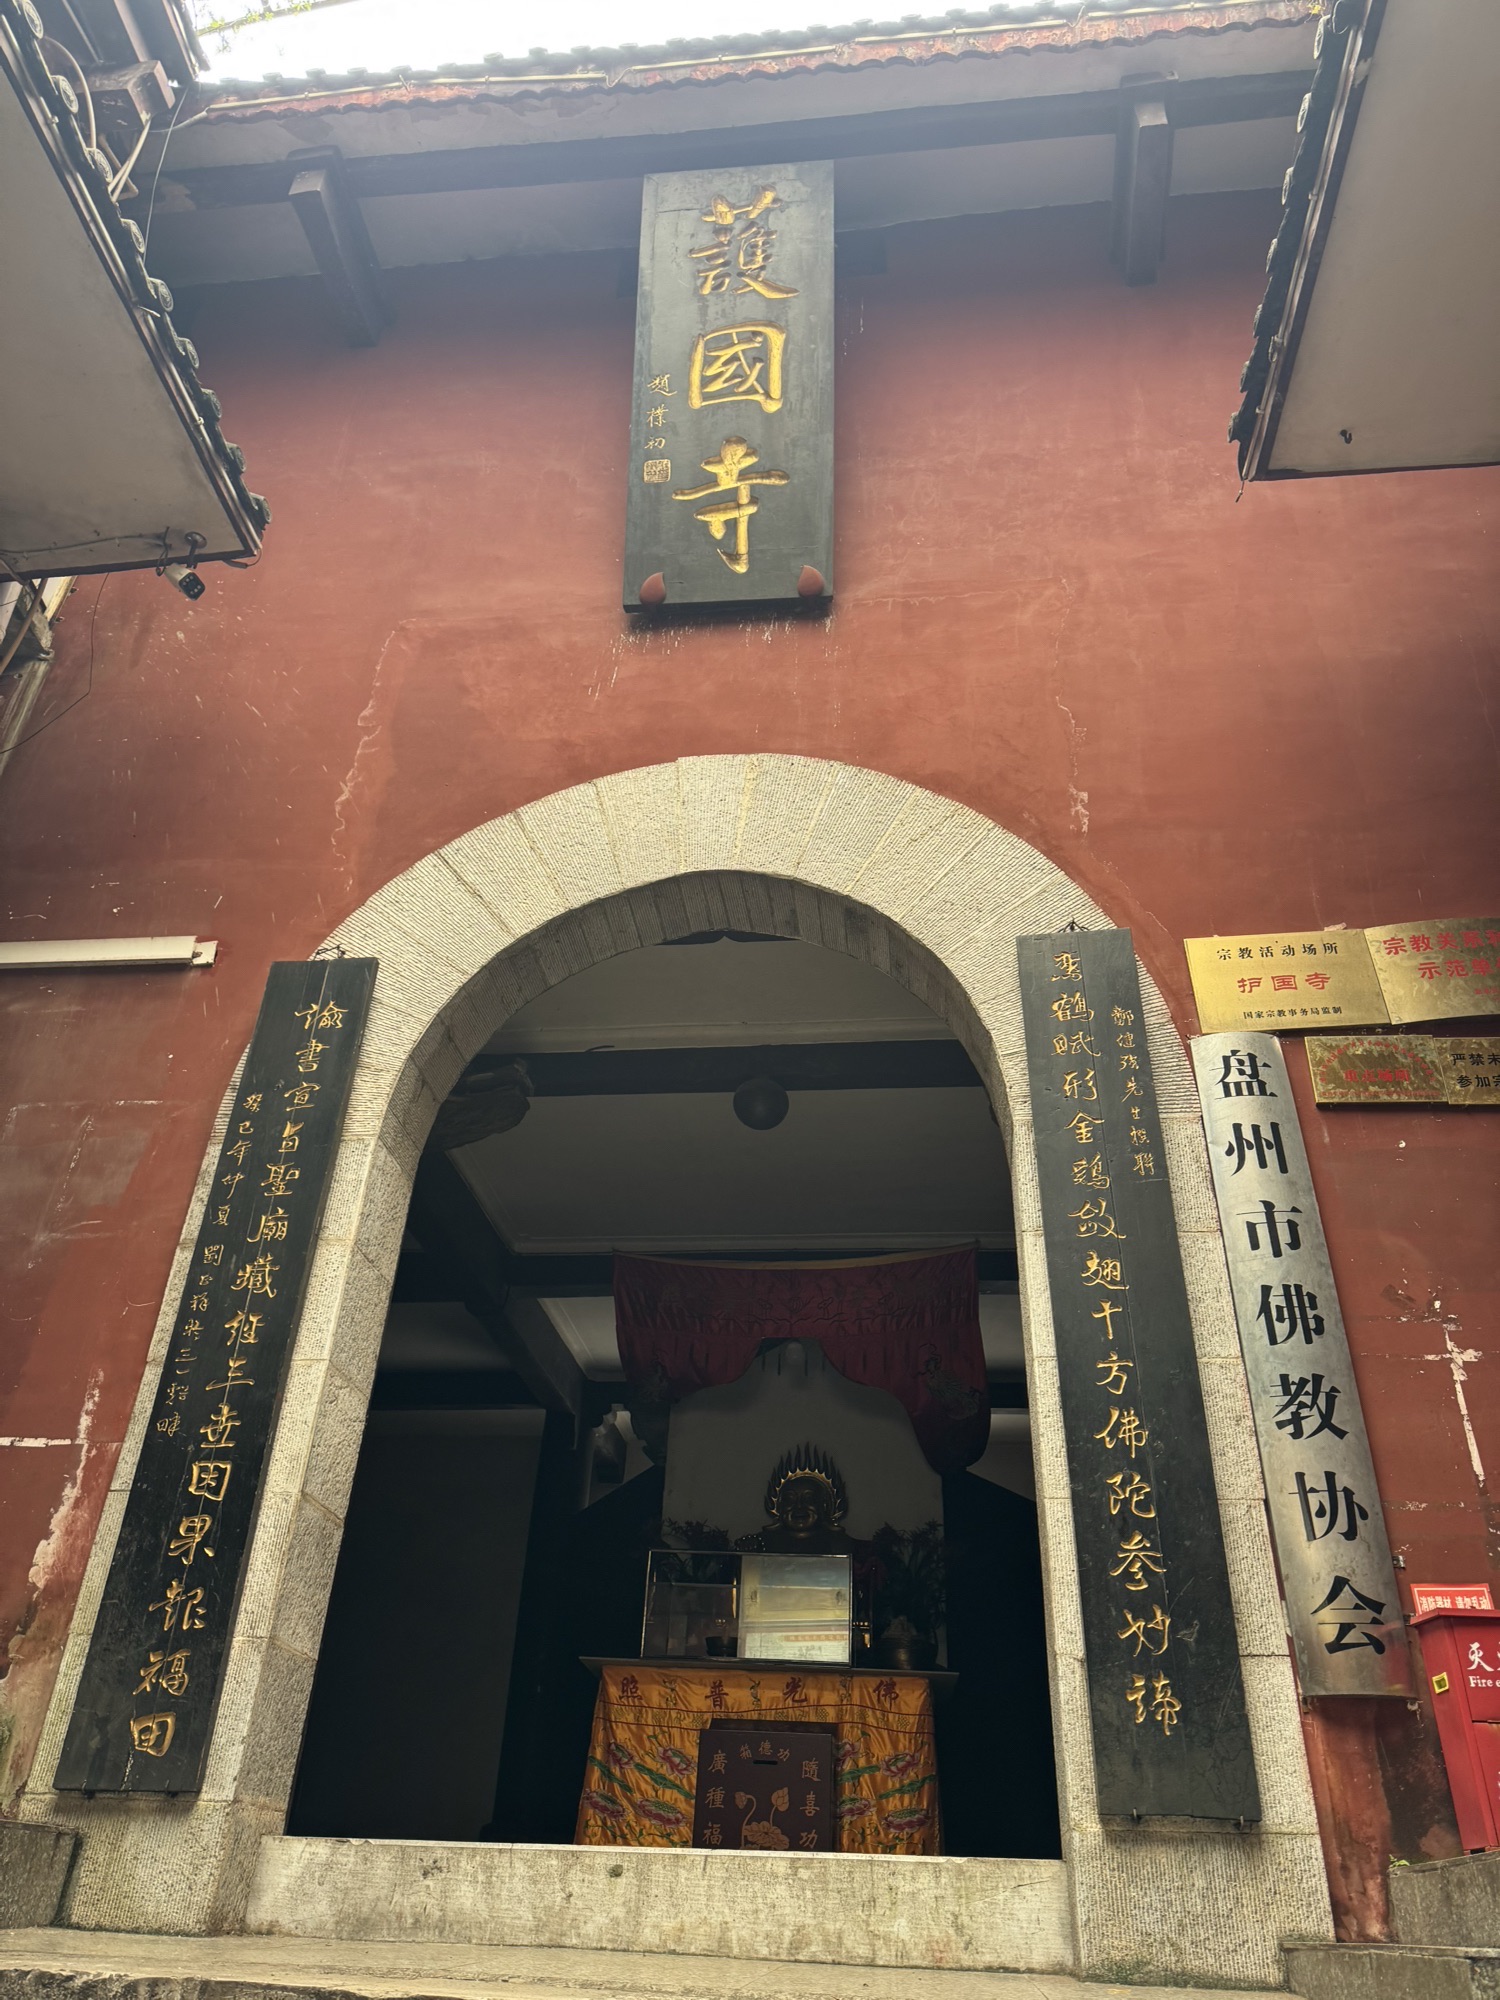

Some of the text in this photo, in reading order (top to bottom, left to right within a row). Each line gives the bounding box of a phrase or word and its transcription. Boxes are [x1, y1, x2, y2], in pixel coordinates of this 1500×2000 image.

[672, 184, 800, 574] 護國寺
[1217, 942, 1339, 960] 宗教活动场所
[1418, 957, 1500, 981] 示范单
[1237, 972, 1331, 993] 护国寺
[1243, 1006, 1342, 1019] 国家宗教事务局监制
[1208, 1049, 1388, 1656] 盘州市佛教协会
[1467, 1641, 1500, 1672] 灭
[1468, 1675, 1494, 1688] Fire
